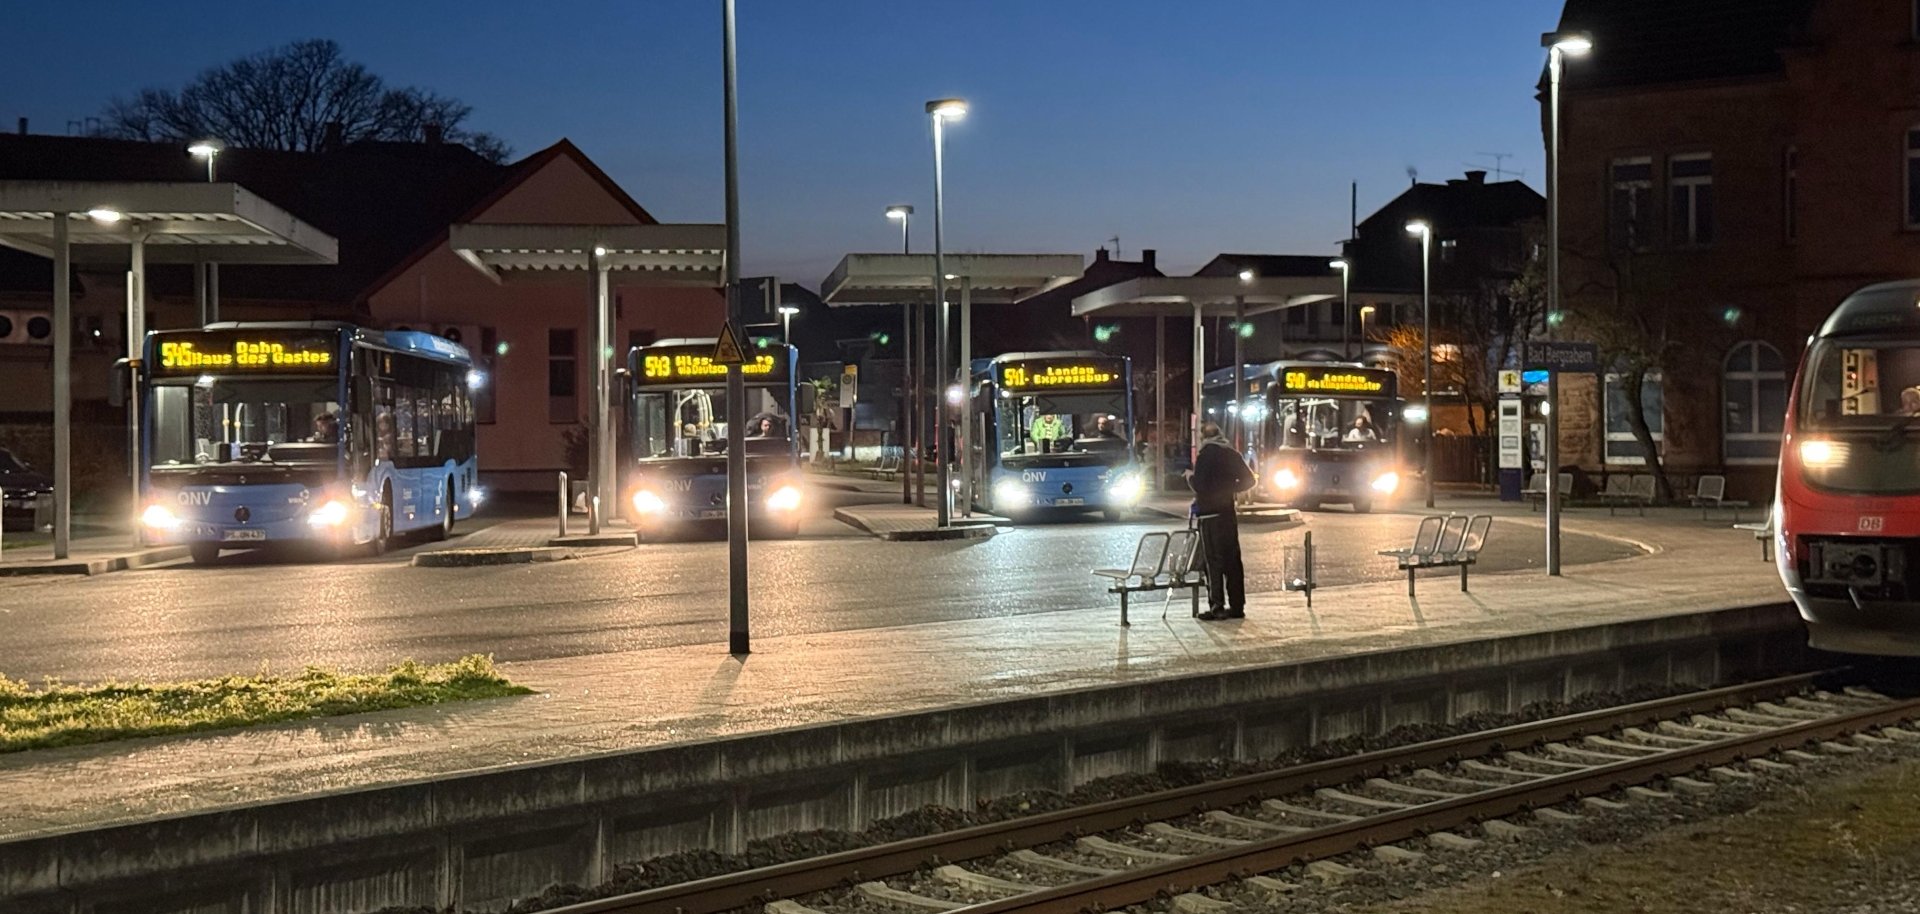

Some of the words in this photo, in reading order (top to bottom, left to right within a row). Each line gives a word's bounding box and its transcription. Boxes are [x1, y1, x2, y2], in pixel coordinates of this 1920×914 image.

[758, 278, 770, 313] 1
[162, 343, 192, 366] 545
[236, 341, 283, 354] Dahn
[192, 352, 232, 365] Haus
[236, 352, 267, 364] des
[272, 350, 330, 364] Gastes
[645, 356, 671, 377] 543
[1047, 366, 1094, 376] Landau
[1004, 368, 1025, 386] 541
[1033, 374, 1109, 385] Expressbus
[1286, 372, 1306, 389] 540
[1324, 373, 1366, 383] Landau
[1859, 517, 1882, 530] DB
